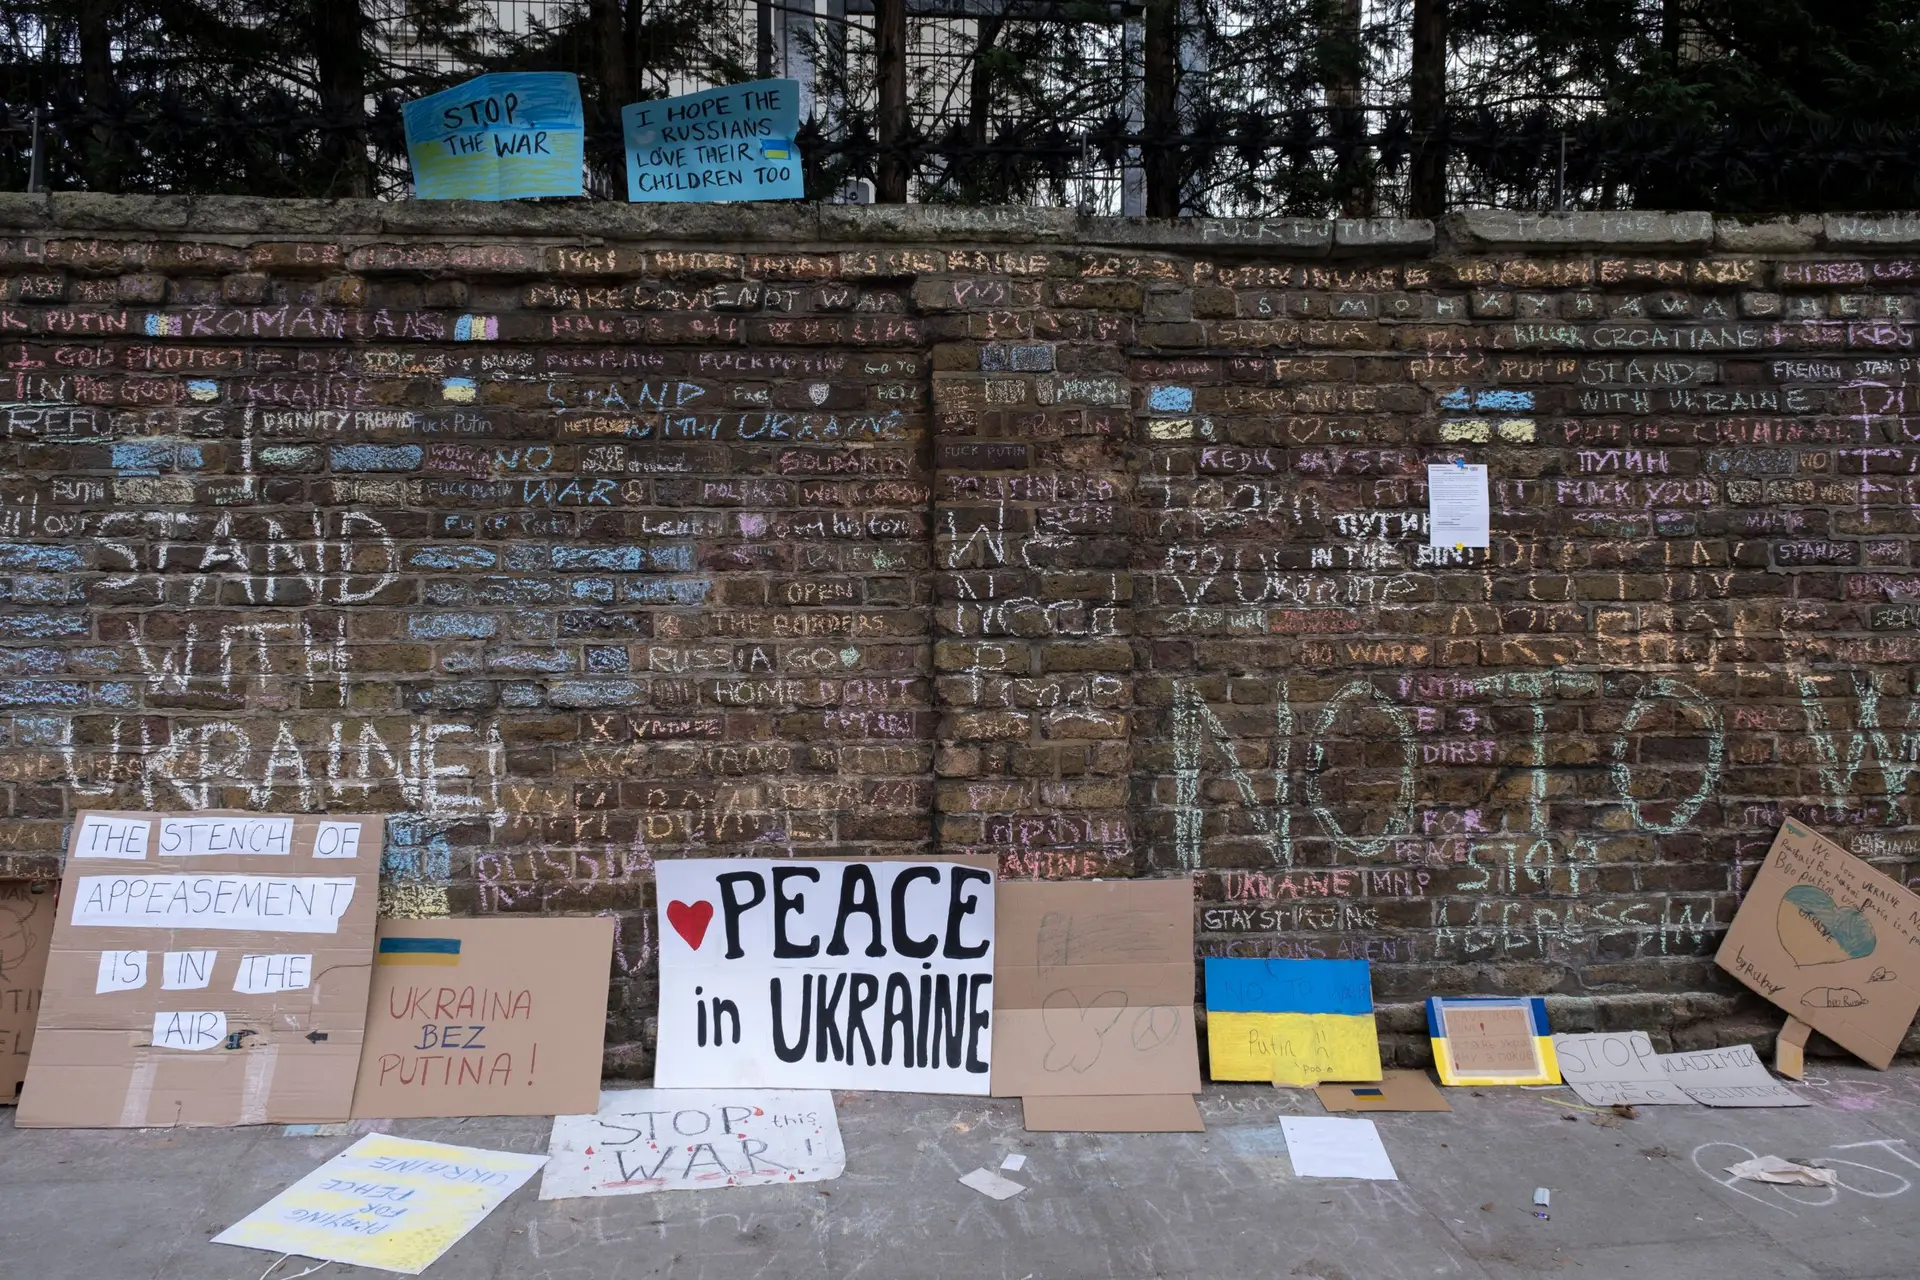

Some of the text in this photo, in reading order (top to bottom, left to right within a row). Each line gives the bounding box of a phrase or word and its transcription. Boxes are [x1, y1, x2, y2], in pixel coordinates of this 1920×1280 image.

[443, 93, 519, 129] STOP
[636, 90, 782, 128] I HOPE THE
[661, 117, 772, 143] RUSSIANS
[443, 131, 551, 164] THE WAR
[637, 141, 755, 168] LOVE THEIR
[638, 168, 791, 198] CHILDREN TOO
[1203, 220, 1397, 242] FUCK PUTIN
[530, 284, 627, 310] MAKE
[45, 310, 128, 332] PUTIN
[1592, 327, 1760, 350] CROATIANS
[54, 347, 244, 369] GOD PROTECT
[1275, 357, 1330, 380] FOR
[1773, 360, 1843, 380] FRENCH
[1579, 388, 1812, 414] WITH UKRAINE
[453, 411, 496, 434] Putin
[494, 446, 554, 473] NO
[944, 444, 1029, 464] FUCK PUTIN
[1575, 450, 1670, 475] ПУТИН
[522, 478, 619, 507] WAR
[1556, 480, 1636, 506] FUCK
[91, 508, 402, 604] STAND
[786, 581, 854, 604] OPEN
[711, 613, 763, 633] THE
[125, 615, 350, 710] WITH
[647, 645, 838, 673] RUSSIA GO
[1345, 641, 1406, 666] WAR
[60, 716, 507, 830] UKRAINE!
[88, 821, 361, 855] THE STENCH OF
[1455, 836, 1599, 897] STOP
[1811, 839, 1903, 909] We UKRAINE
[83, 878, 354, 917] APPEASEMENT
[716, 863, 992, 961] PEACE
[1203, 907, 1257, 932] STAY
[111, 952, 307, 989] IS IN THE
[389, 986, 532, 1021] UKRAINA
[1224, 978, 1369, 1005] NO TO WAR
[164, 1011, 219, 1045] AIR
[694, 961, 993, 1074] in UKRAINE
[413, 1023, 486, 1050] BEZ
[1248, 1028, 1297, 1058] Putin
[1555, 1034, 1655, 1074] STOP
[1580, 1081, 1668, 1104] THE WAR
[595, 1104, 817, 1147] STOP this
[369, 1156, 509, 1187] UKRAINE
[283, 1208, 390, 1237] PRAYING
[359, 1202, 409, 1219] FOR
